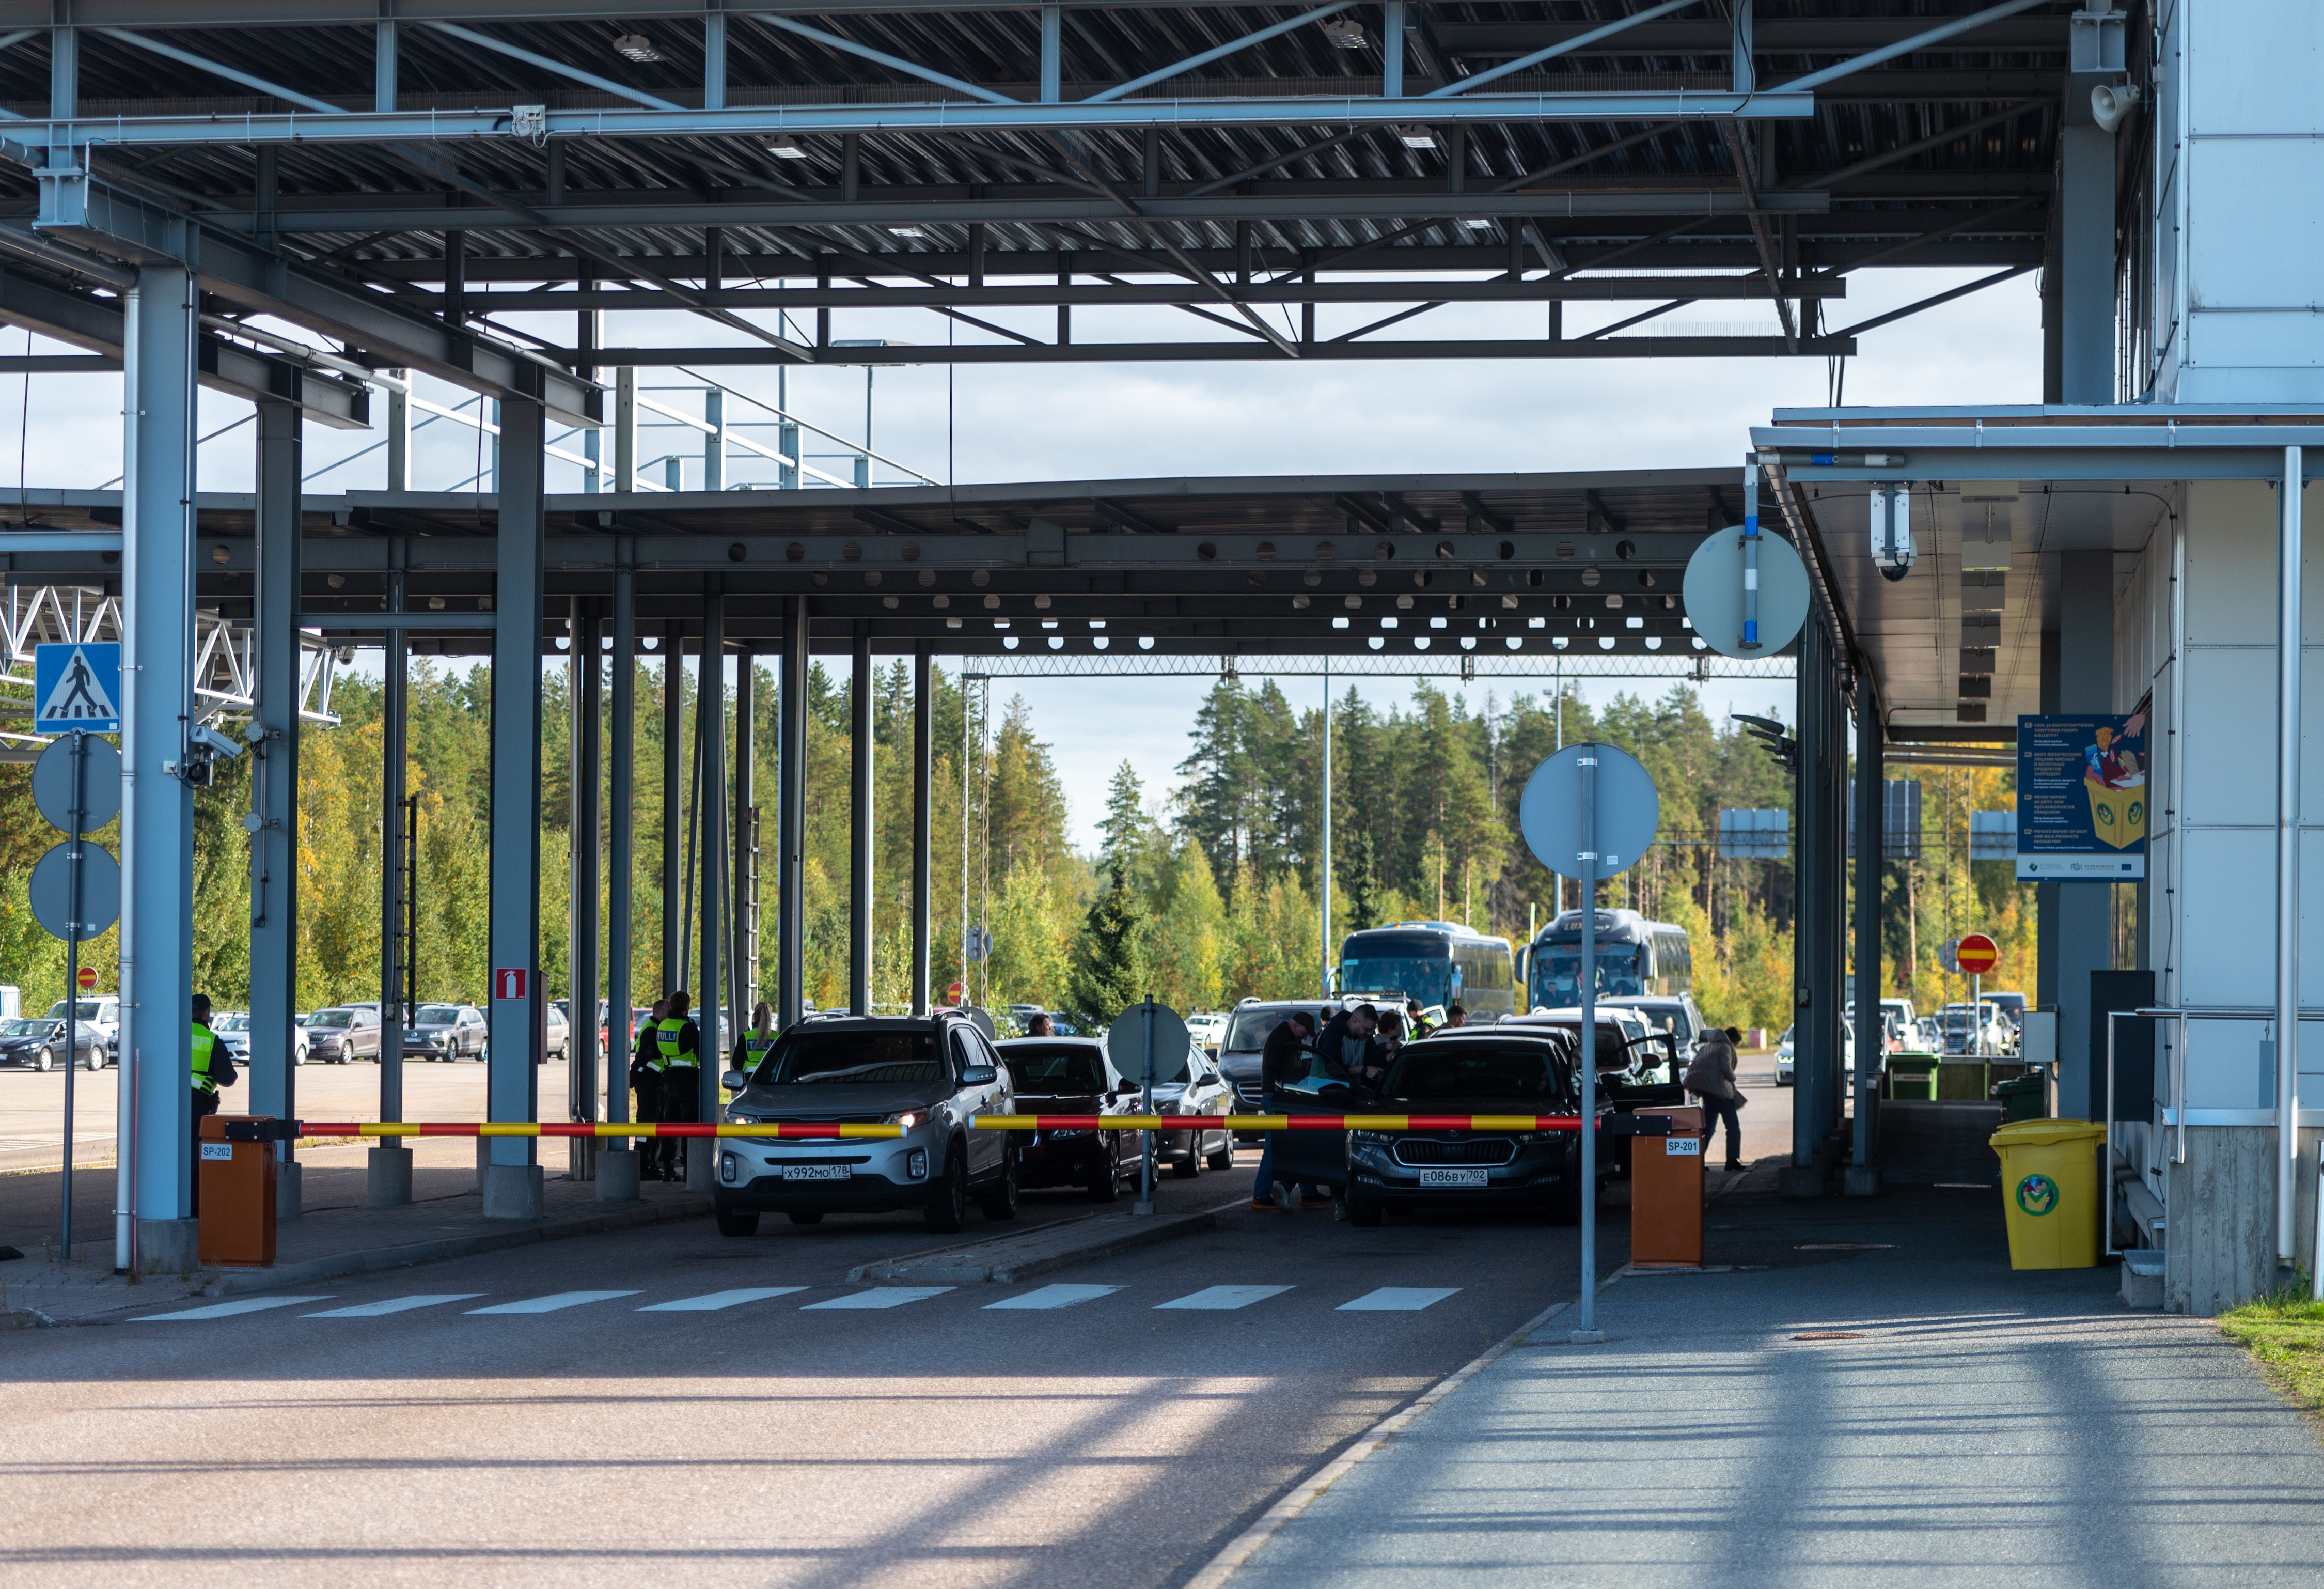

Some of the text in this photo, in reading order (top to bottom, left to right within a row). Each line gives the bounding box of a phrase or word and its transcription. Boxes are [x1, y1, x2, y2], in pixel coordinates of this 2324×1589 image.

[657, 1032, 676, 1041] TULLI
[1668, 1142, 1697, 1151] SP-201
[203, 1147, 230, 1156] SP-202
[831, 1165, 847, 1175] 178
[1468, 1170, 1485, 1179] 702
